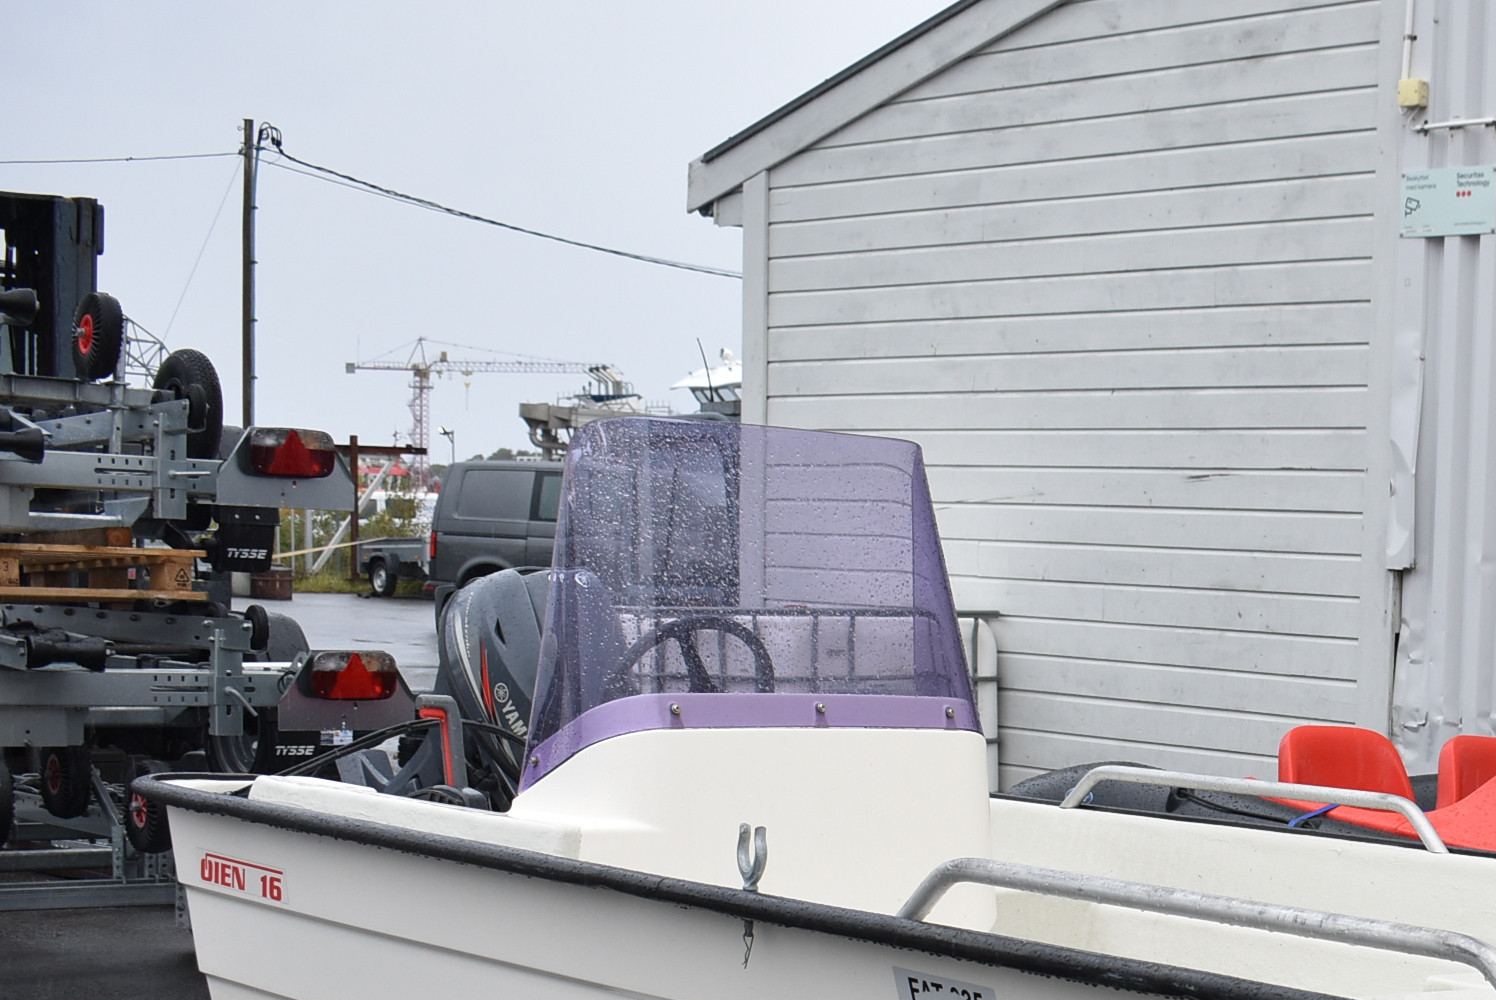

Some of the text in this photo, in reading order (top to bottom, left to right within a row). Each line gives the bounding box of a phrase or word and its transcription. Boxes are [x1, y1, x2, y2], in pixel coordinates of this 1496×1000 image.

[226, 547, 268, 560] TYSSE
[502, 699, 529, 740] YAM
[275, 745, 316, 756] TYSSE
[260, 874, 283, 902] 16
